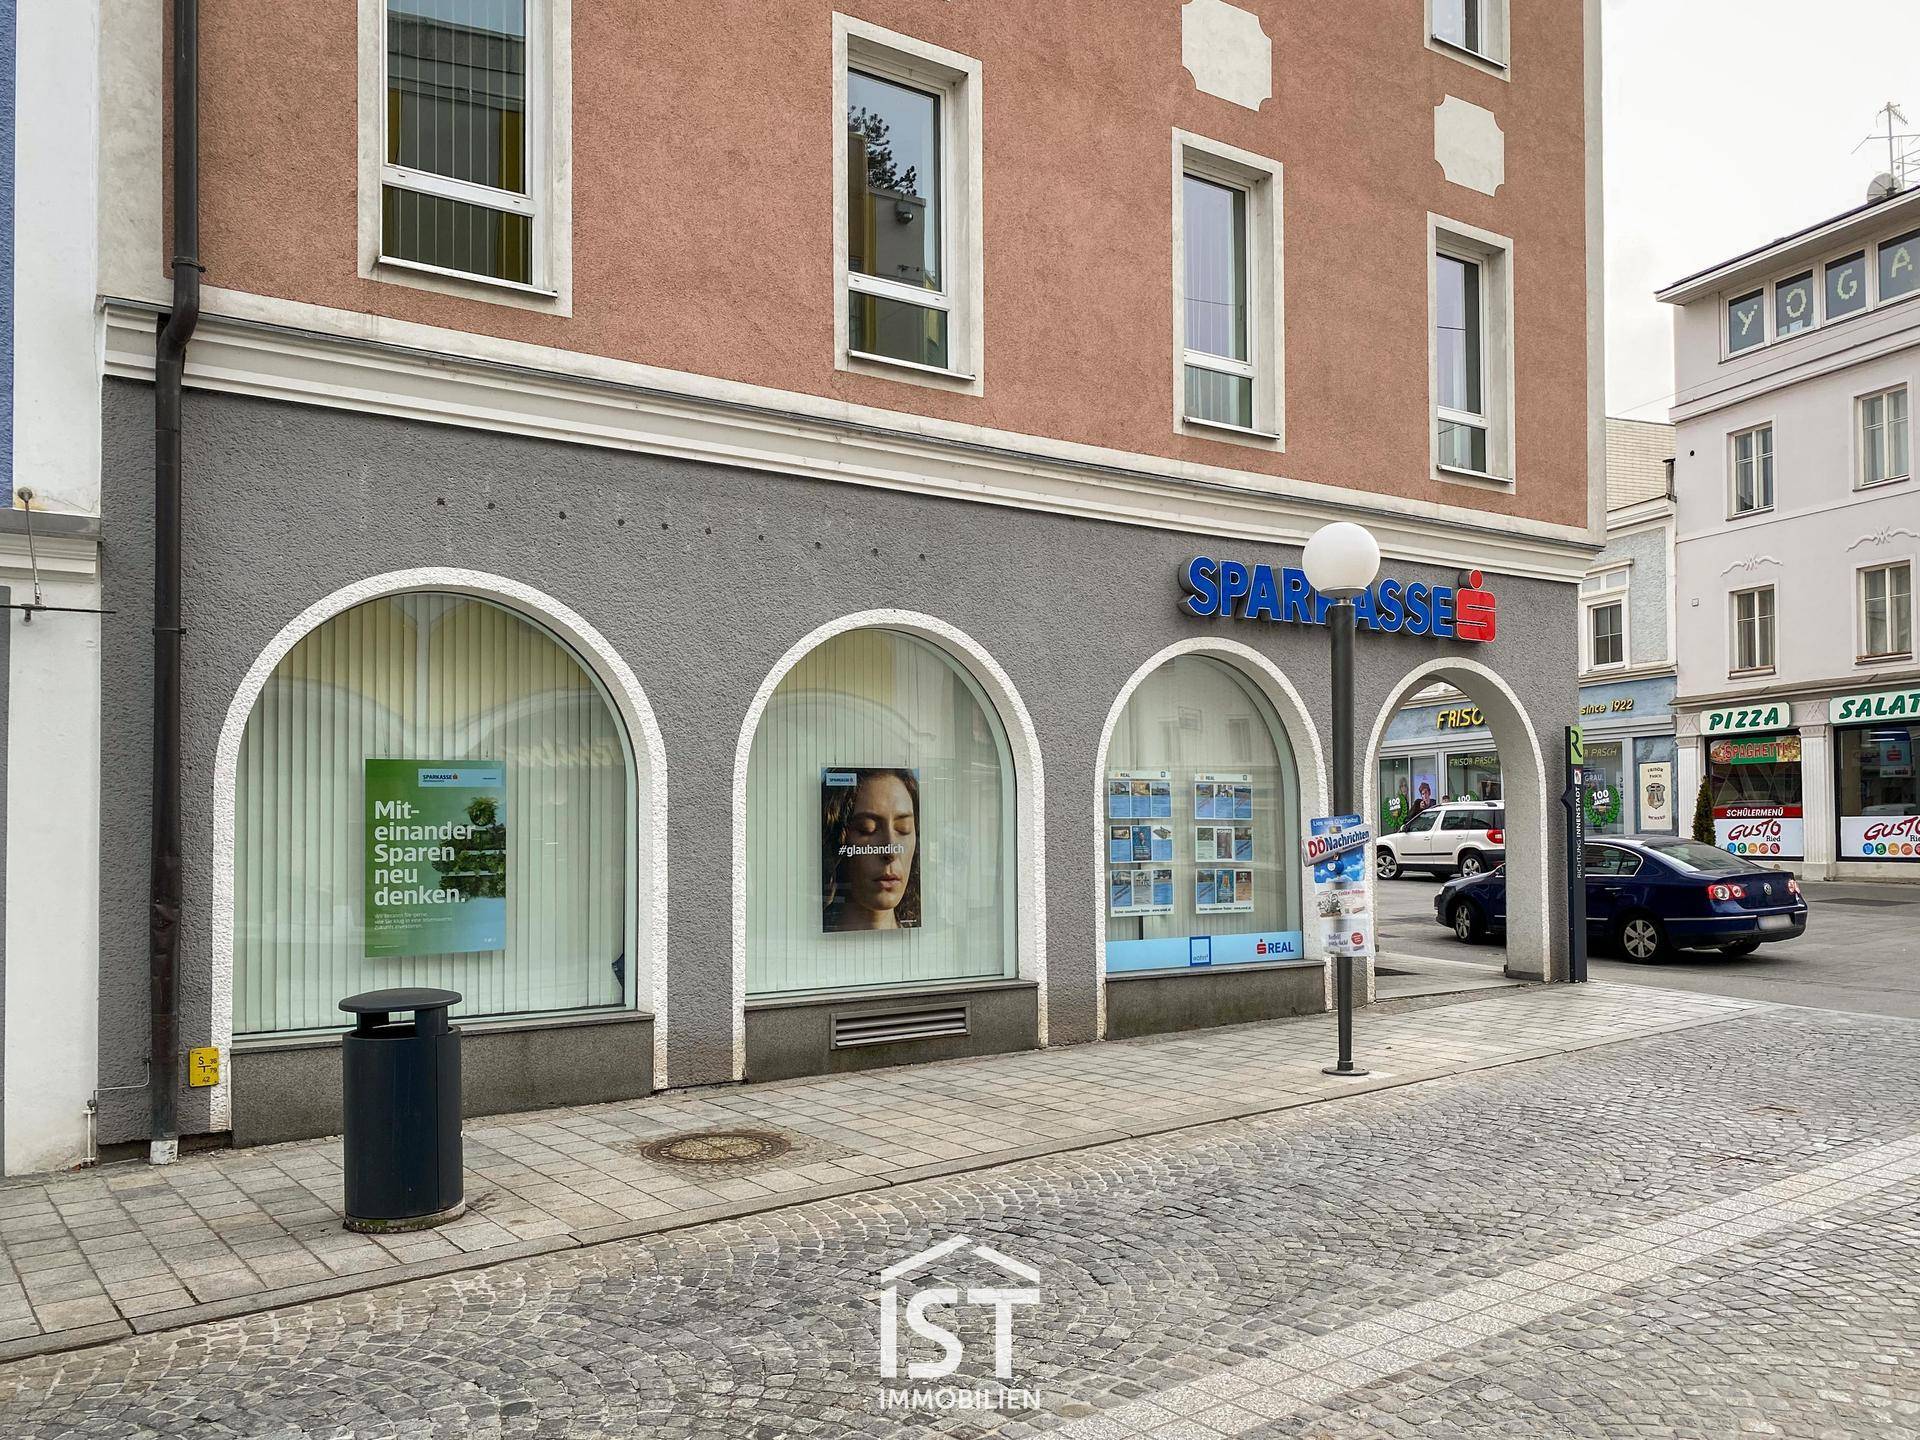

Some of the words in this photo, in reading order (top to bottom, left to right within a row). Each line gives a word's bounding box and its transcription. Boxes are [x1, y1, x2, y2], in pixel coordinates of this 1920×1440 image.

[1737, 247, 1913, 336] YOGA
[1581, 704, 1606, 715] since
[1611, 699, 1634, 712] 1922
[1709, 707, 1779, 731] PIZZA
[1723, 741, 1786, 759] SPAGHETTI
[1388, 797, 1401, 806] 100
[1592, 789, 1609, 799] 100
[375, 800, 420, 820] Mit-
[1726, 808, 1784, 817] SCHÜLERMENÜ
[374, 821, 476, 841] einander
[1728, 818, 1782, 841] GUSTO
[374, 843, 455, 866] Sparen
[838, 844, 905, 857] #glaubandich
[375, 868, 418, 885] neu
[374, 885, 466, 906] denken.
[1268, 942, 1294, 954] REAL
